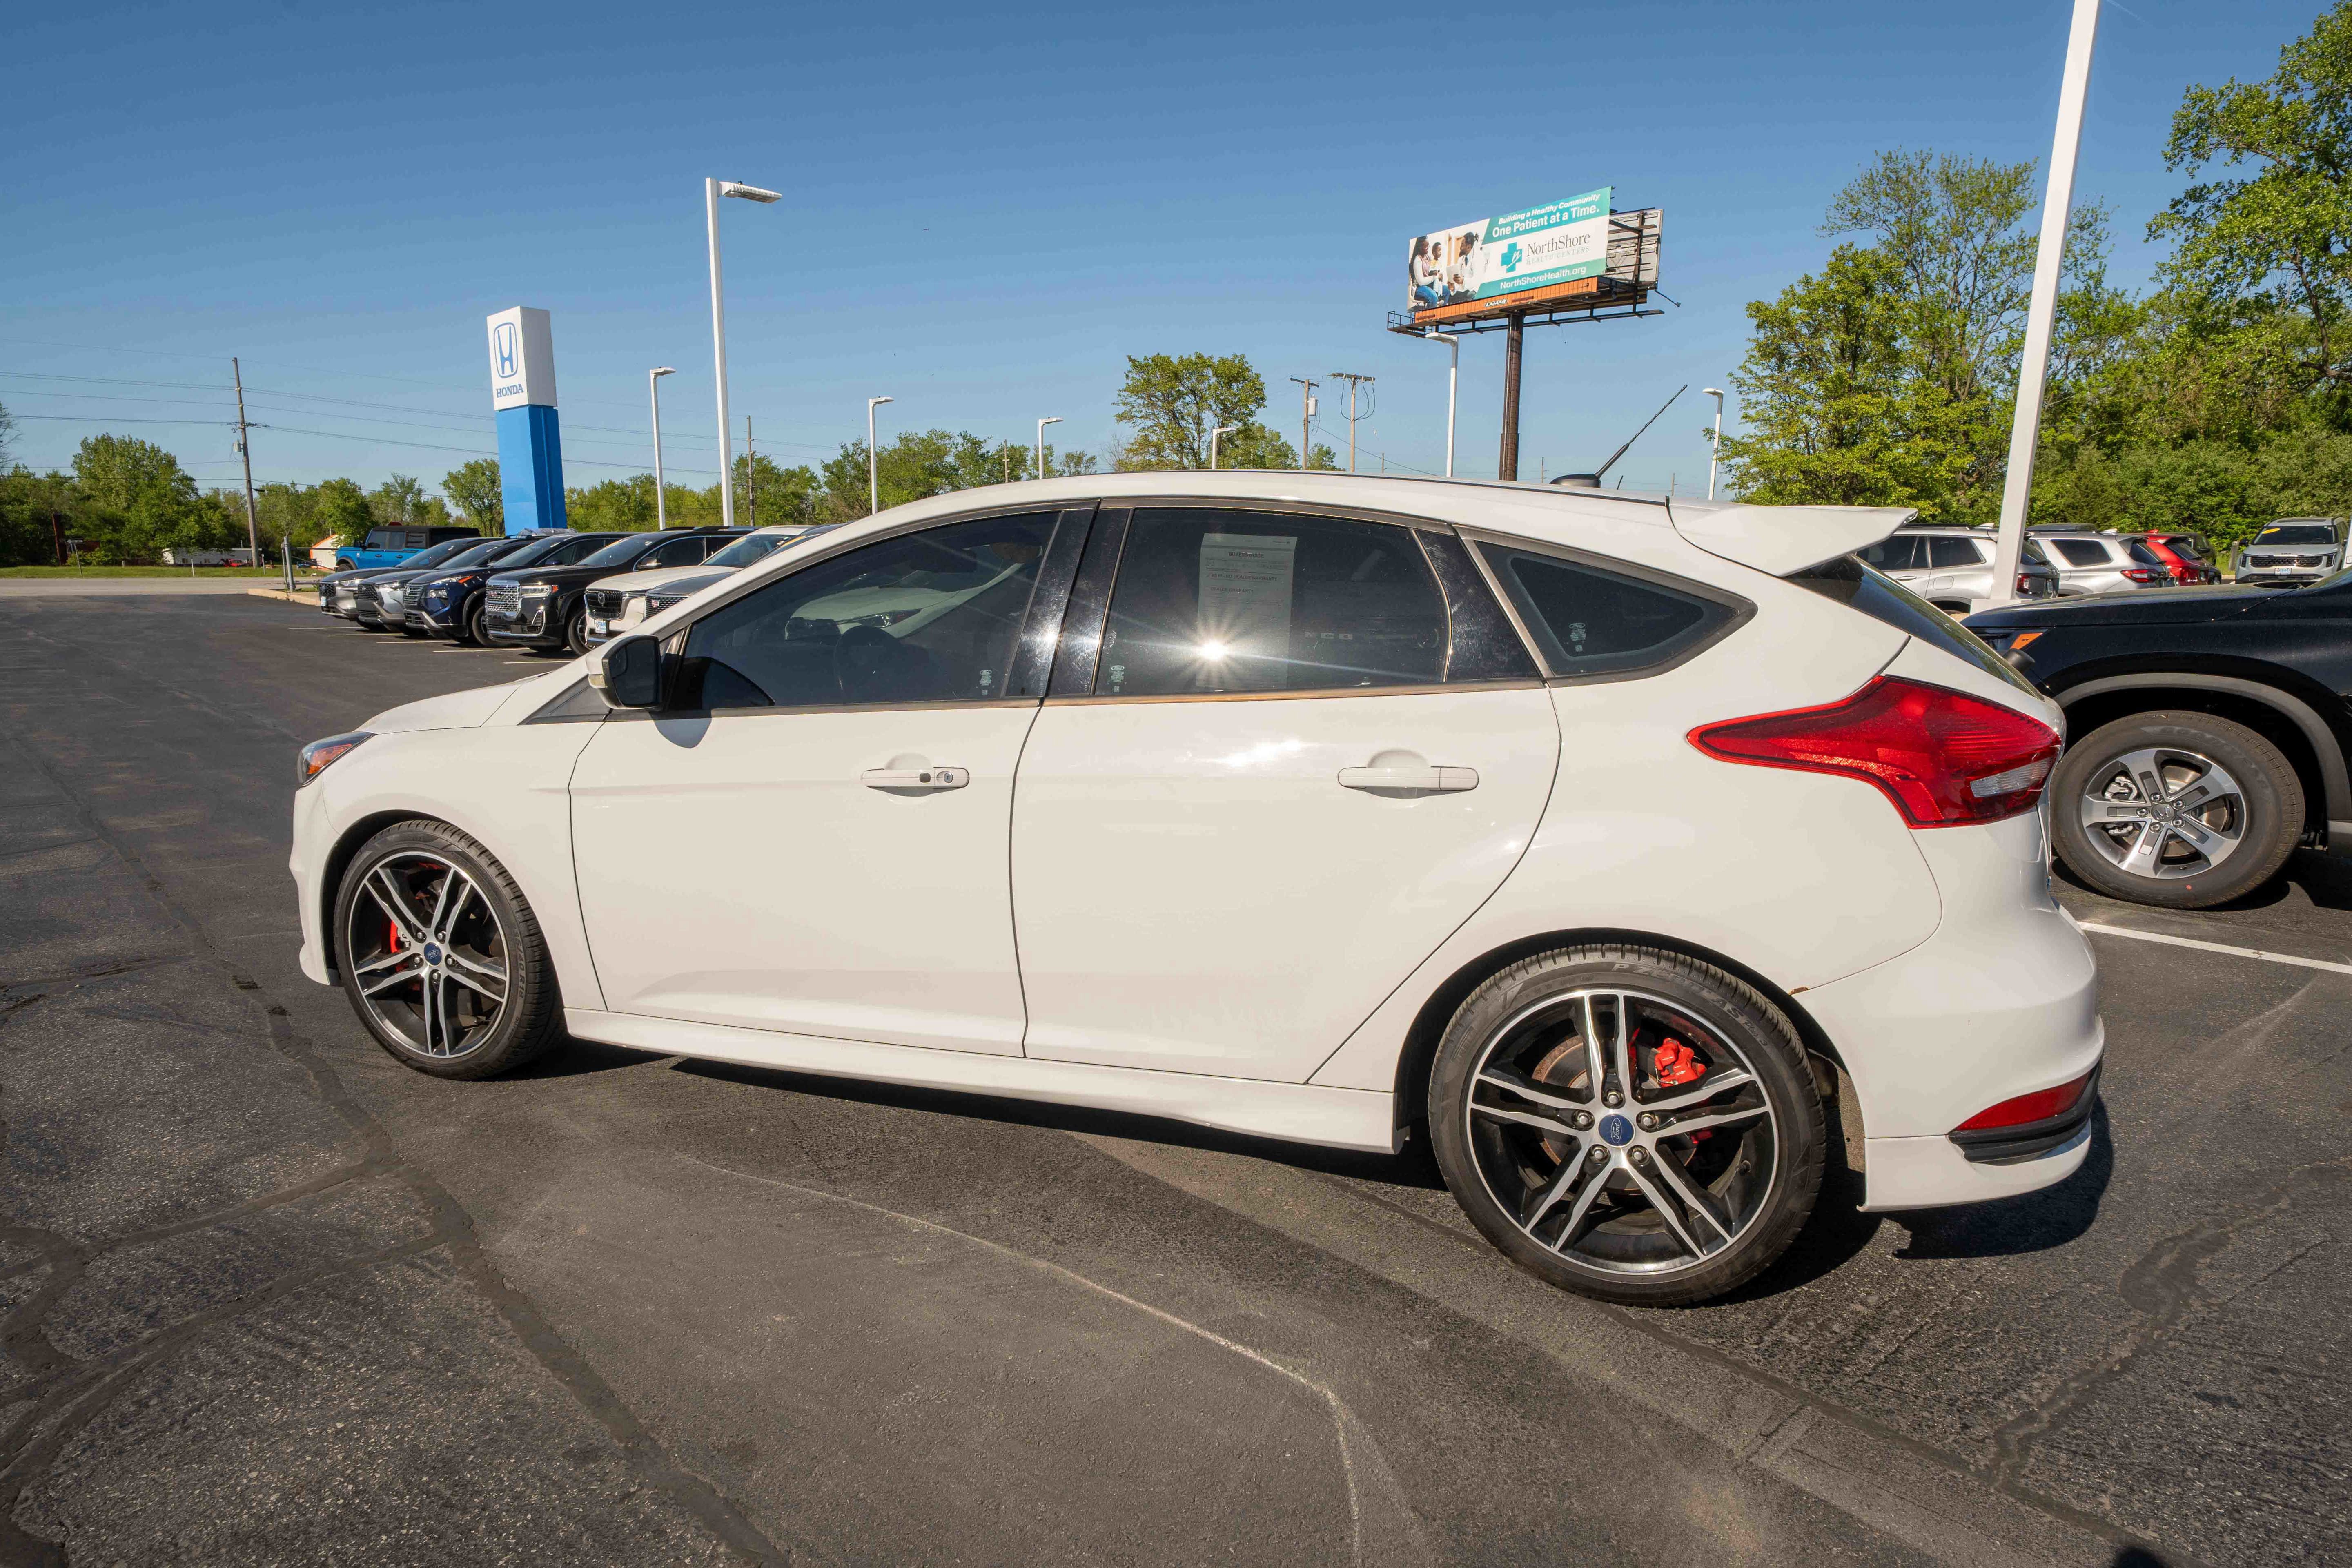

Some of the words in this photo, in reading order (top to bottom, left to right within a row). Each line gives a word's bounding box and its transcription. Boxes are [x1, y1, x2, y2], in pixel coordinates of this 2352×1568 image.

[1499, 212, 1525, 225] Building
[1531, 204, 1558, 216] Healthy
[1559, 193, 1600, 209] Community
[1492, 227, 1511, 237] One
[1514, 216, 1548, 232] Patient
[1550, 212, 1560, 224] at
[1562, 212, 1568, 221] a
[1571, 205, 1600, 218] Time.
[1526, 234, 1590, 257] NorthShore
[1526, 253, 1553, 265] HEALTH
[1557, 247, 1589, 259] CENTERS
[1500, 266, 1586, 290] NorthShoreHealth.org
[496, 383, 524, 398] HONDA
[1611, 963, 1629, 971] P
[1613, 1122, 1621, 1140] Ford
